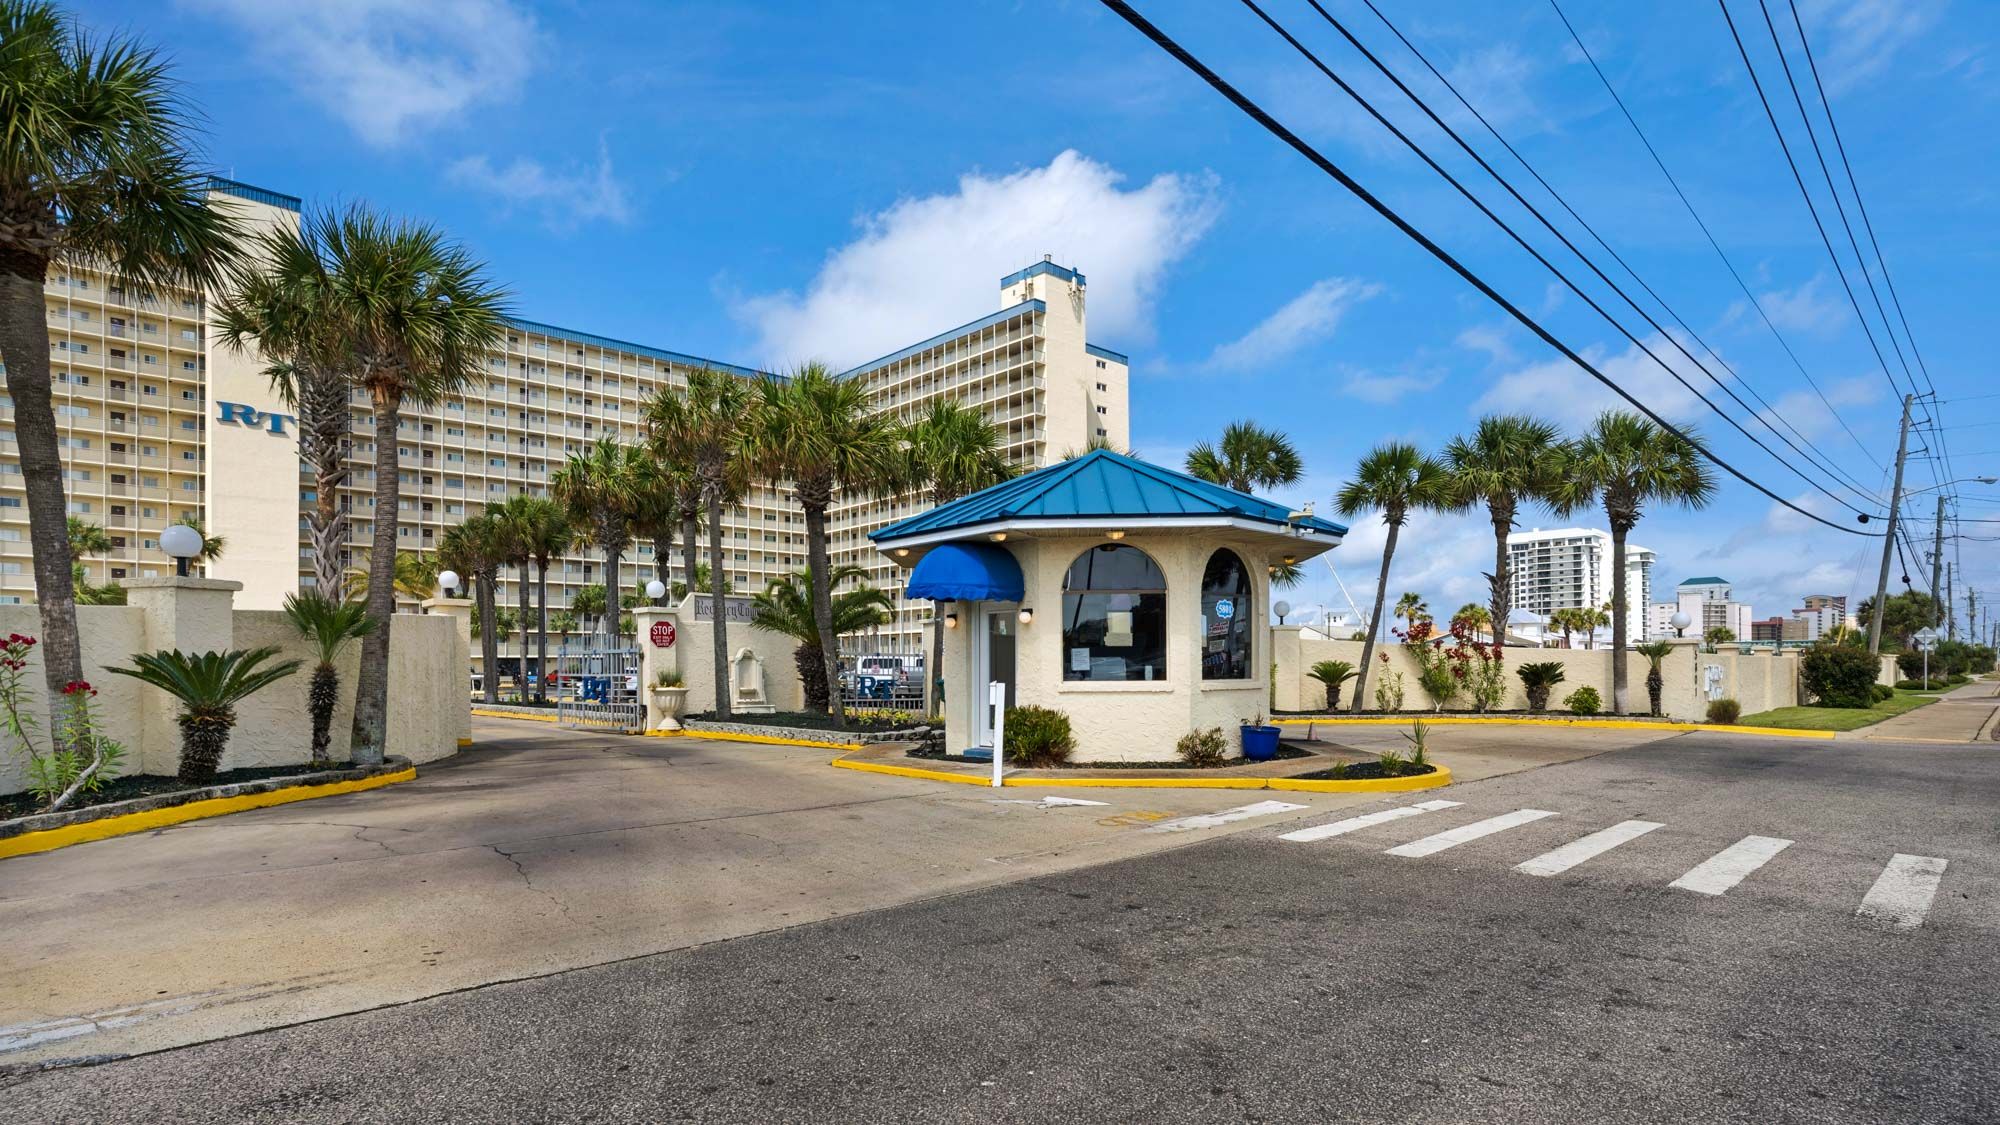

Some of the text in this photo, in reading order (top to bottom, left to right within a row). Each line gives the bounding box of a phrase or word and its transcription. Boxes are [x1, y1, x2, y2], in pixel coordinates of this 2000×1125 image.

[216, 400, 297, 434] RT
[696, 599, 738, 619] Regcy
[652, 625, 674, 635] STOP
[858, 677, 897, 700] RT
